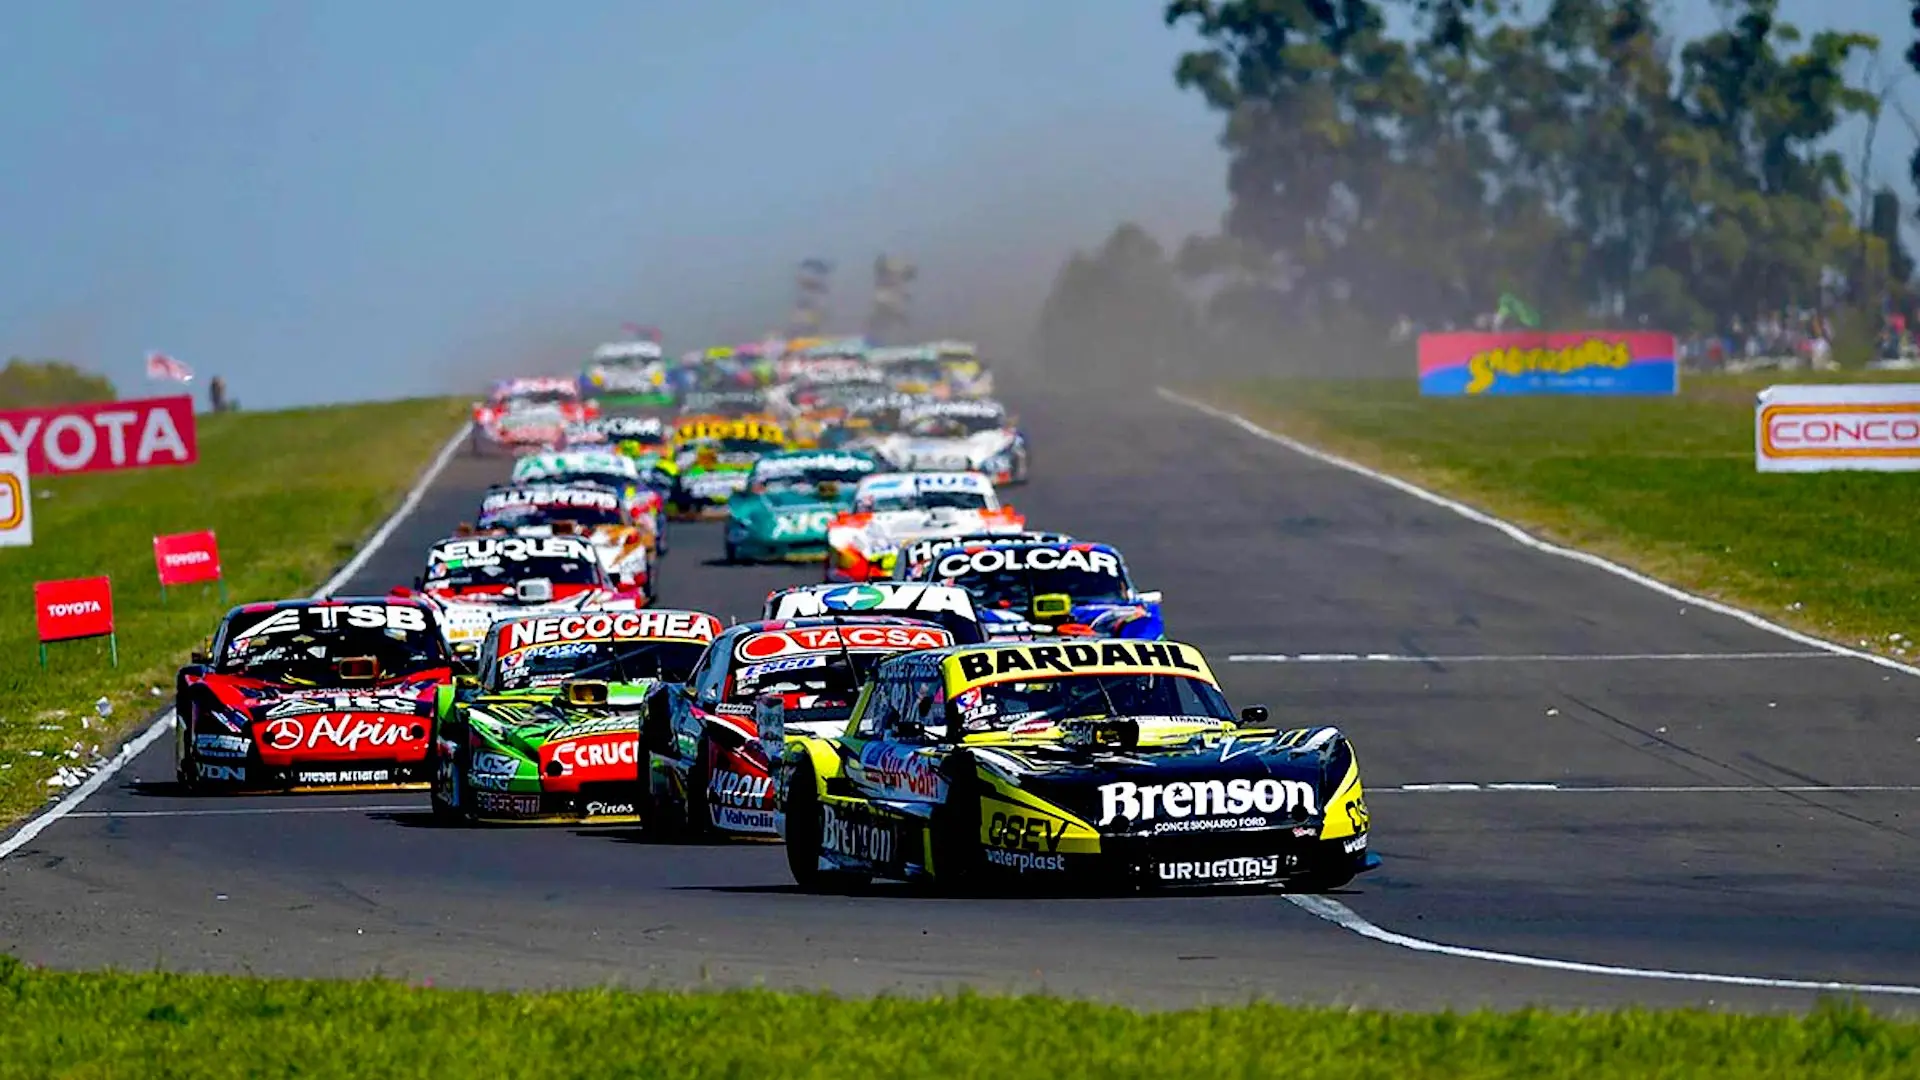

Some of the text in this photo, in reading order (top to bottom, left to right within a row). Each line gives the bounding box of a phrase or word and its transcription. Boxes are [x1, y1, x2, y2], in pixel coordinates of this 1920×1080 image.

[1774, 420, 1919, 442] CONCO
[164, 551, 210, 567] TOYOTA
[428, 538, 597, 566] NEUQUEN
[48, 601, 101, 617] TOYOTA
[308, 605, 427, 631] TSB
[510, 614, 713, 649] NECOCHEA
[958, 643, 1200, 681] BARDAHL
[1098, 779, 1318, 826] Brenson
[1155, 816, 1266, 832] CONCESIONARIO FORD
[985, 849, 1065, 873] waterplast
[1159, 857, 1278, 879] URUGUAY
